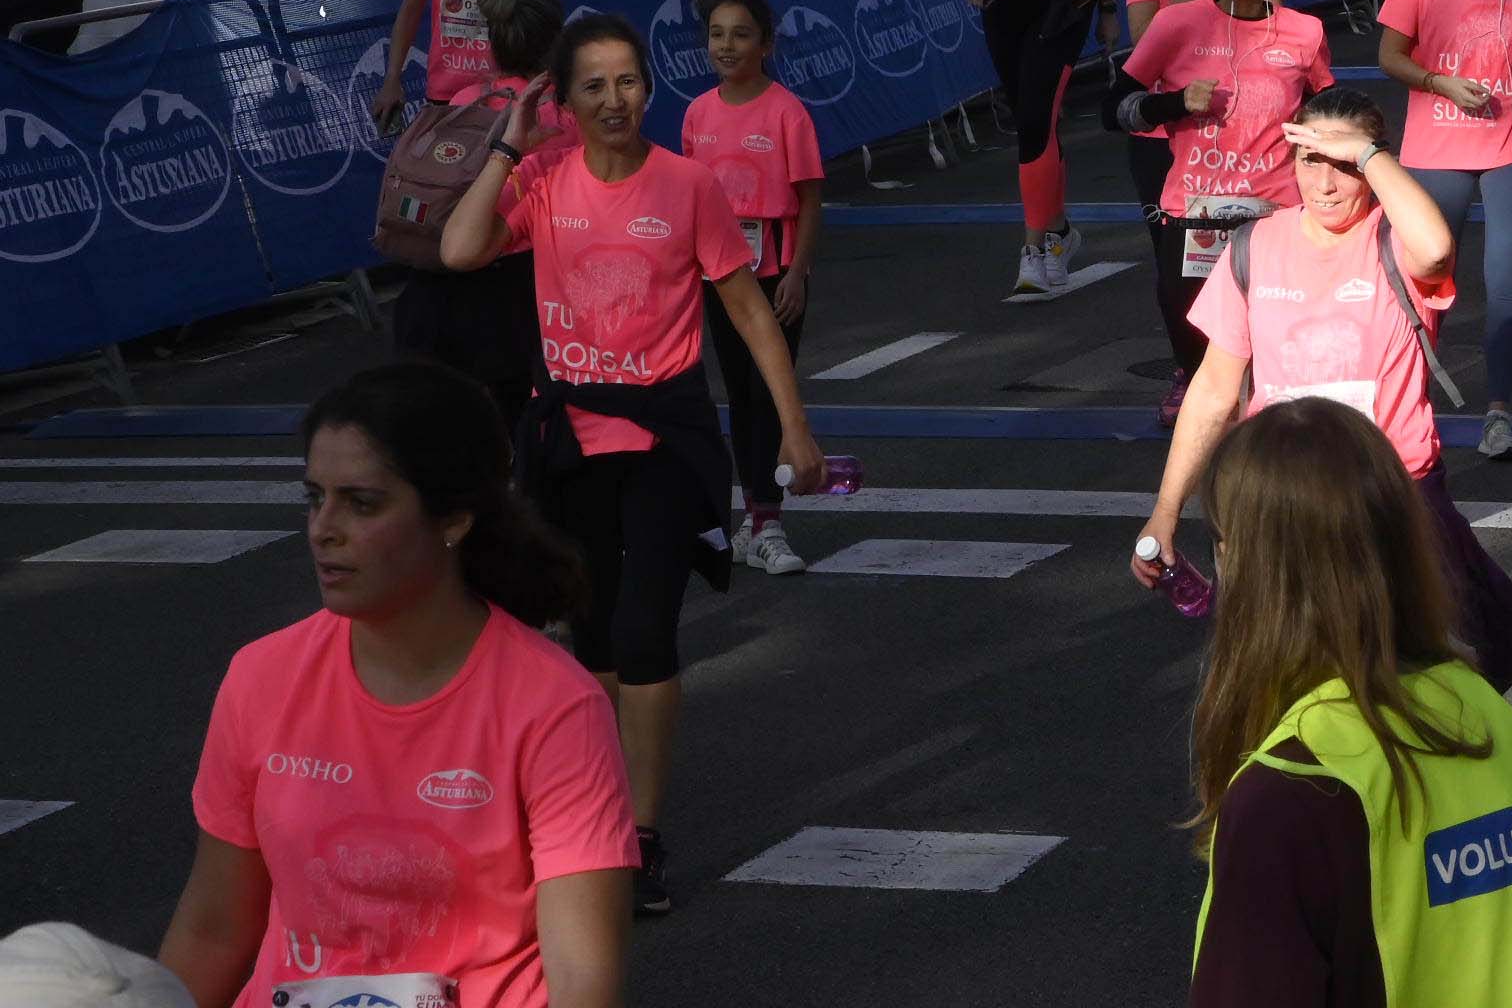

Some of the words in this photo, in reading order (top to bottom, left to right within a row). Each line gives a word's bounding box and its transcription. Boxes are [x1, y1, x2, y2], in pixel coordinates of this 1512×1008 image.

[1194, 45, 1234, 57] OYSHO
[442, 52, 490, 71] SUMA
[1438, 53, 1459, 71] TU
[1432, 102, 1496, 122] SUMA
[692, 133, 718, 145] YSHO
[112, 143, 225, 205] ASTURIANA
[1183, 173, 1252, 194] SUMA
[1256, 285, 1305, 303] OYSHO
[543, 300, 575, 330] TU
[543, 337, 653, 376] DORSAL
[267, 752, 353, 784] OYSHO
[419, 779, 488, 801] ASTURIANA
